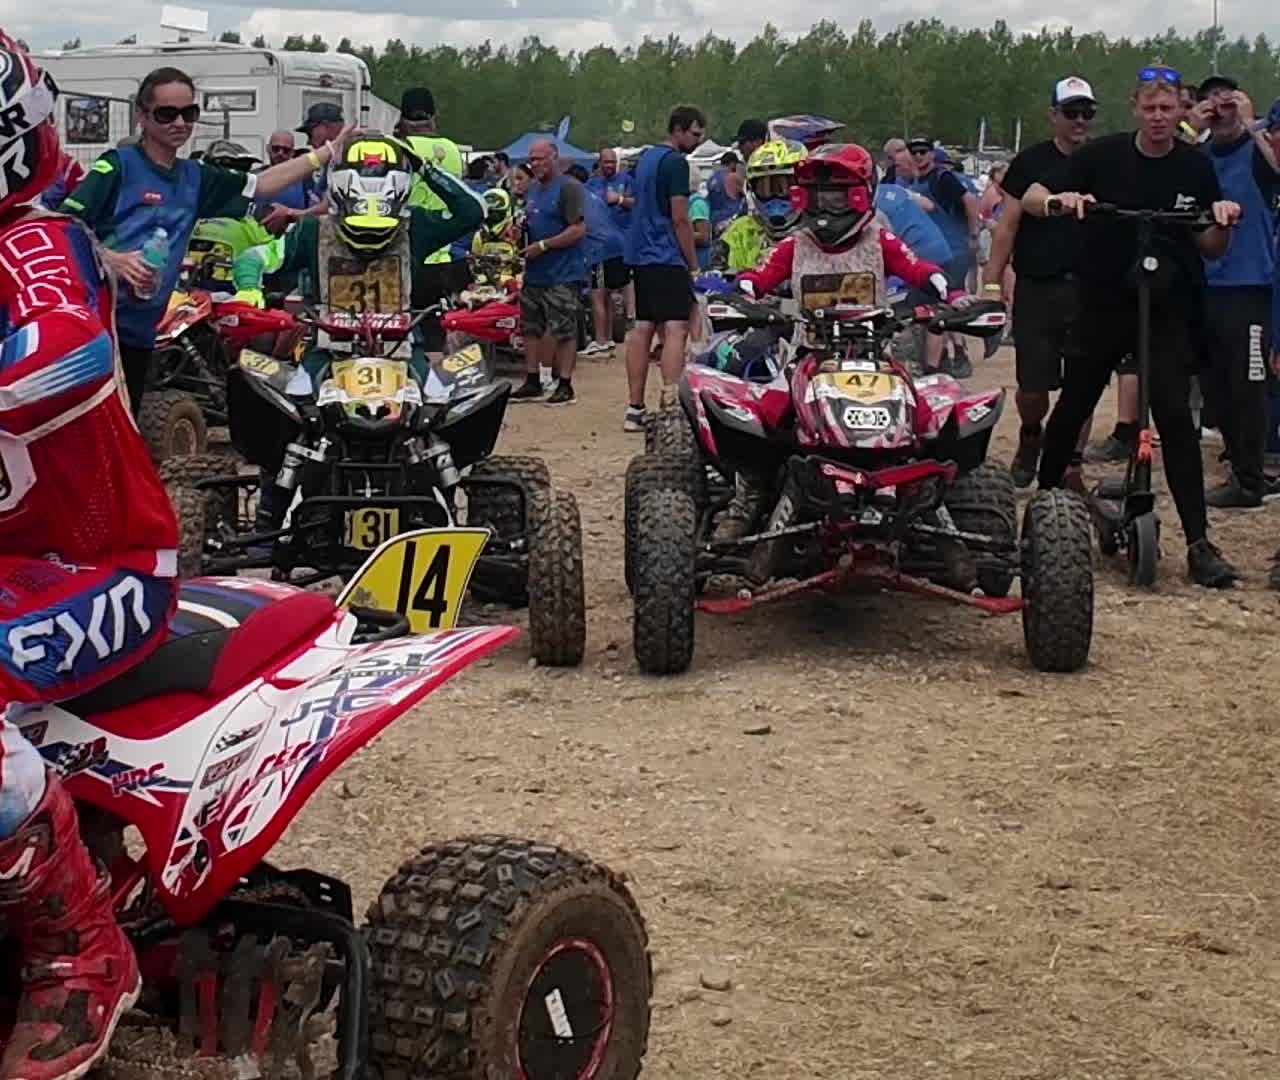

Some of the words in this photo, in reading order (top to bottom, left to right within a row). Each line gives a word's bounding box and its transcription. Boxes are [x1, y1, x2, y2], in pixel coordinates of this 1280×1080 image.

[357, 366, 383, 386] 31
[361, 511, 391, 548] 31
[396, 541, 451, 629] 14
[8, 575, 151, 673] FXR
